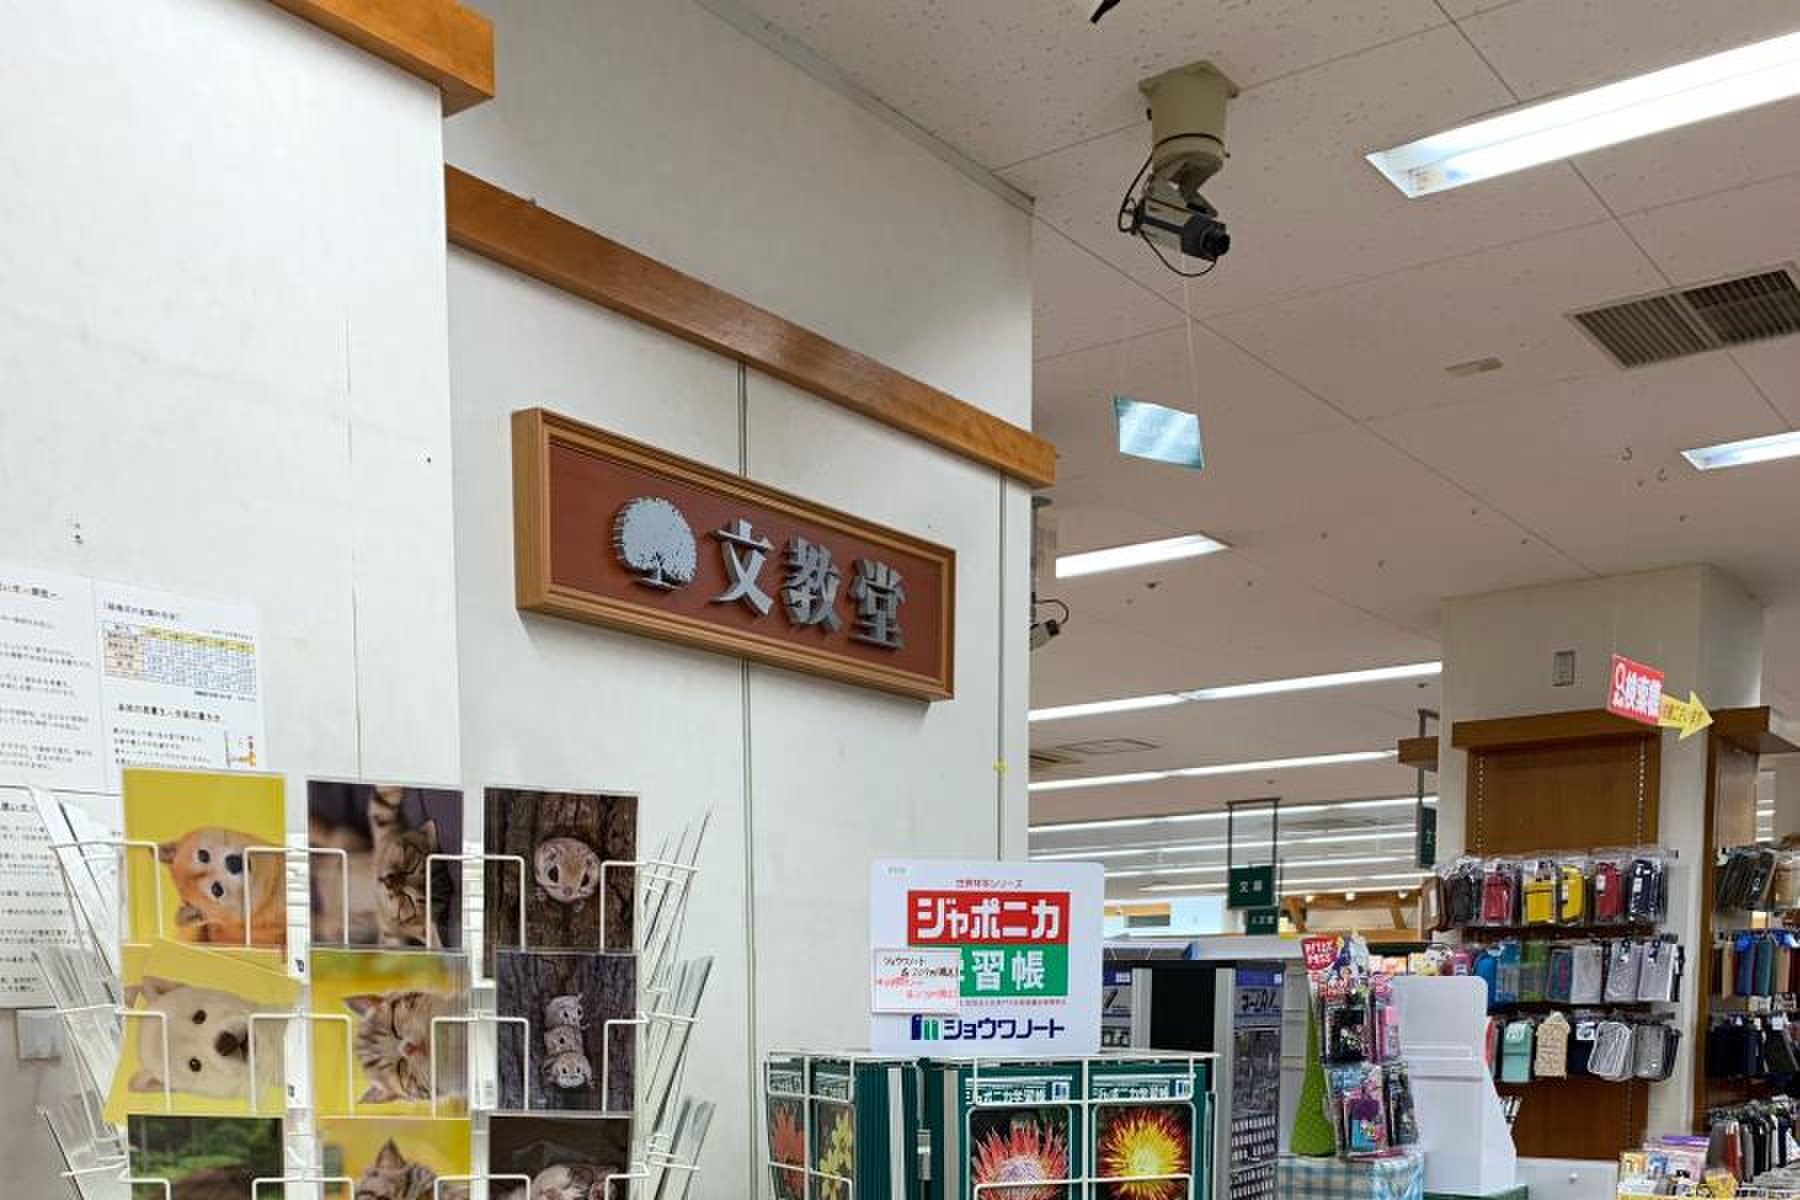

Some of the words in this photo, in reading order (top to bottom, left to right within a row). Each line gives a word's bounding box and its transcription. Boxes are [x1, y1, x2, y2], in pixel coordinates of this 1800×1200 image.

[706, 518, 905, 649] 文教堂
[916, 897, 1060, 940] ジャポニカ
[960, 950, 1045, 991] 習帳
[943, 1017, 1065, 1039] ショウワノート
